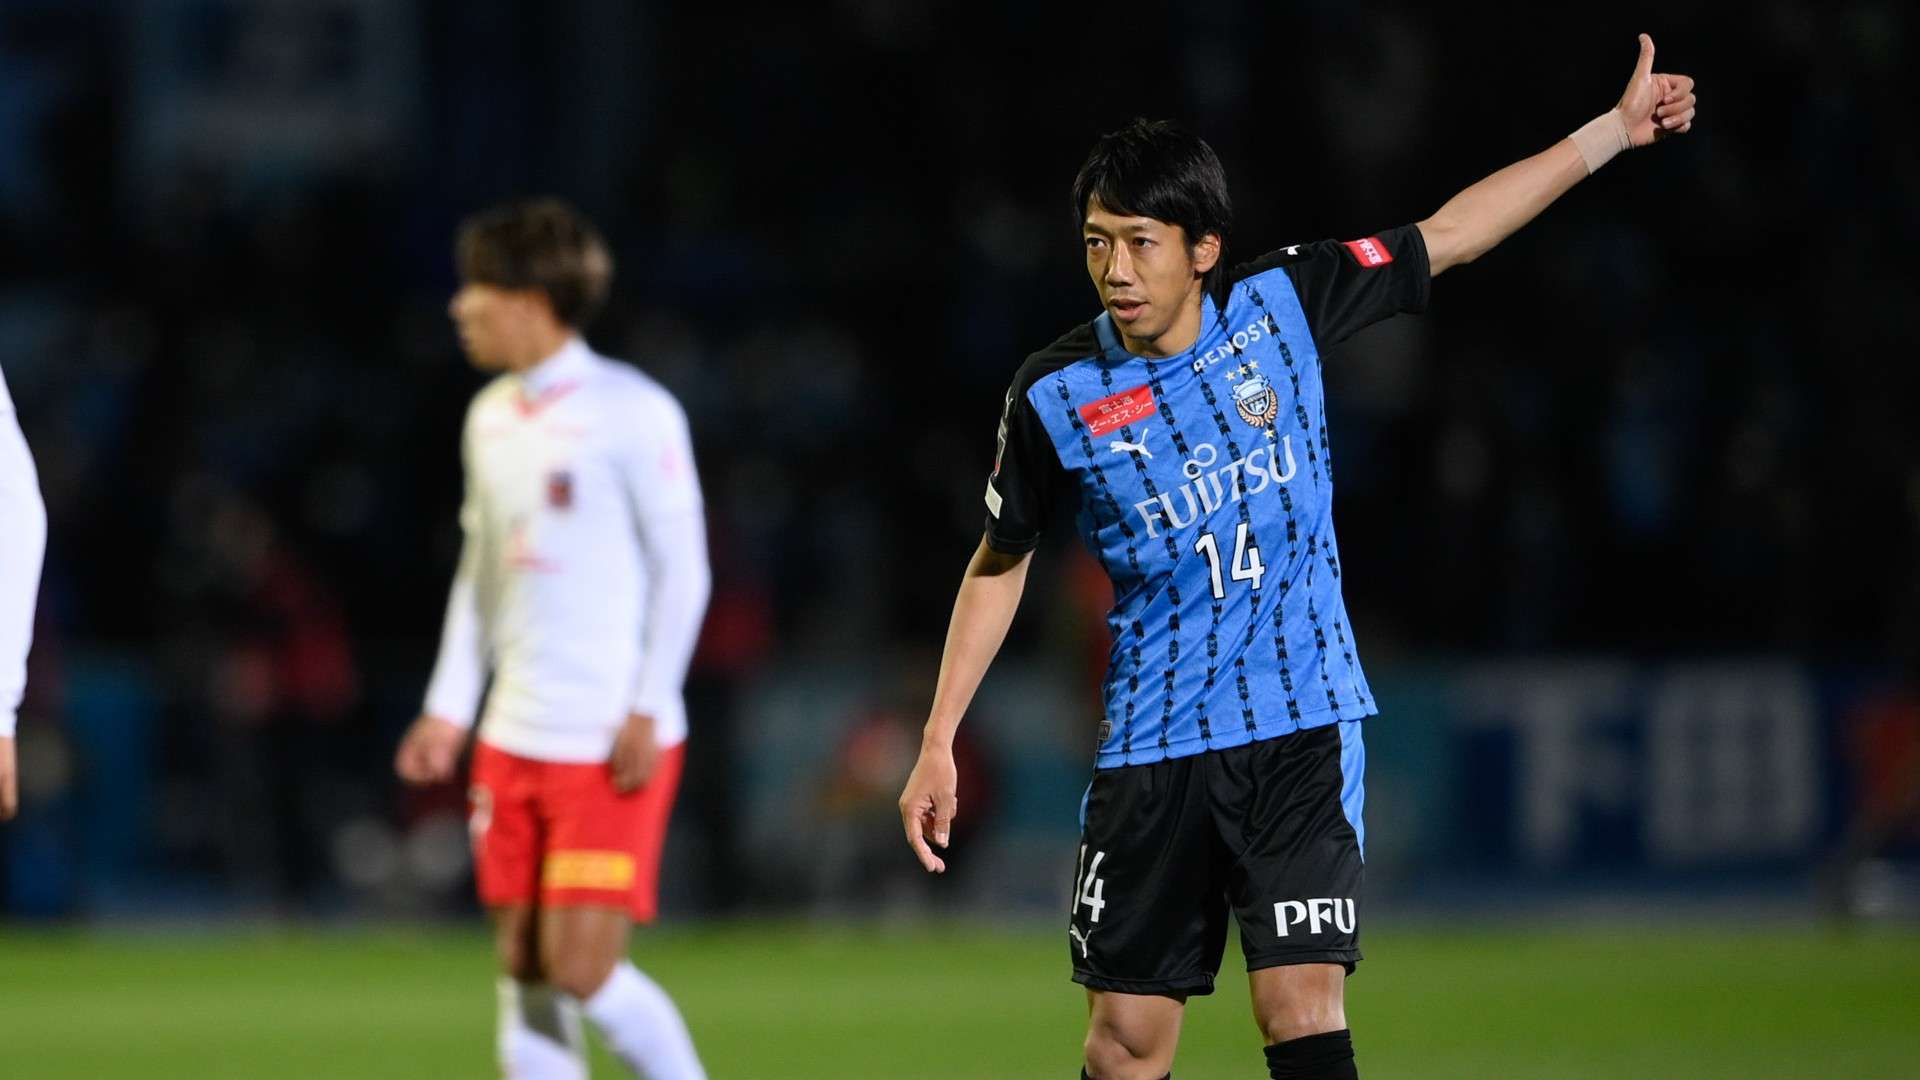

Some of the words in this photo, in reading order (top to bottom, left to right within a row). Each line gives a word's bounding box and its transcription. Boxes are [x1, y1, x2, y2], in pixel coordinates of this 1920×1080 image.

[1193, 314, 1271, 372] RENOSY
[1133, 434, 1297, 539] FUJITSU
[1194, 522, 1266, 600] 14
[1072, 843, 1105, 923] 14
[1273, 898, 1356, 938] PFU
